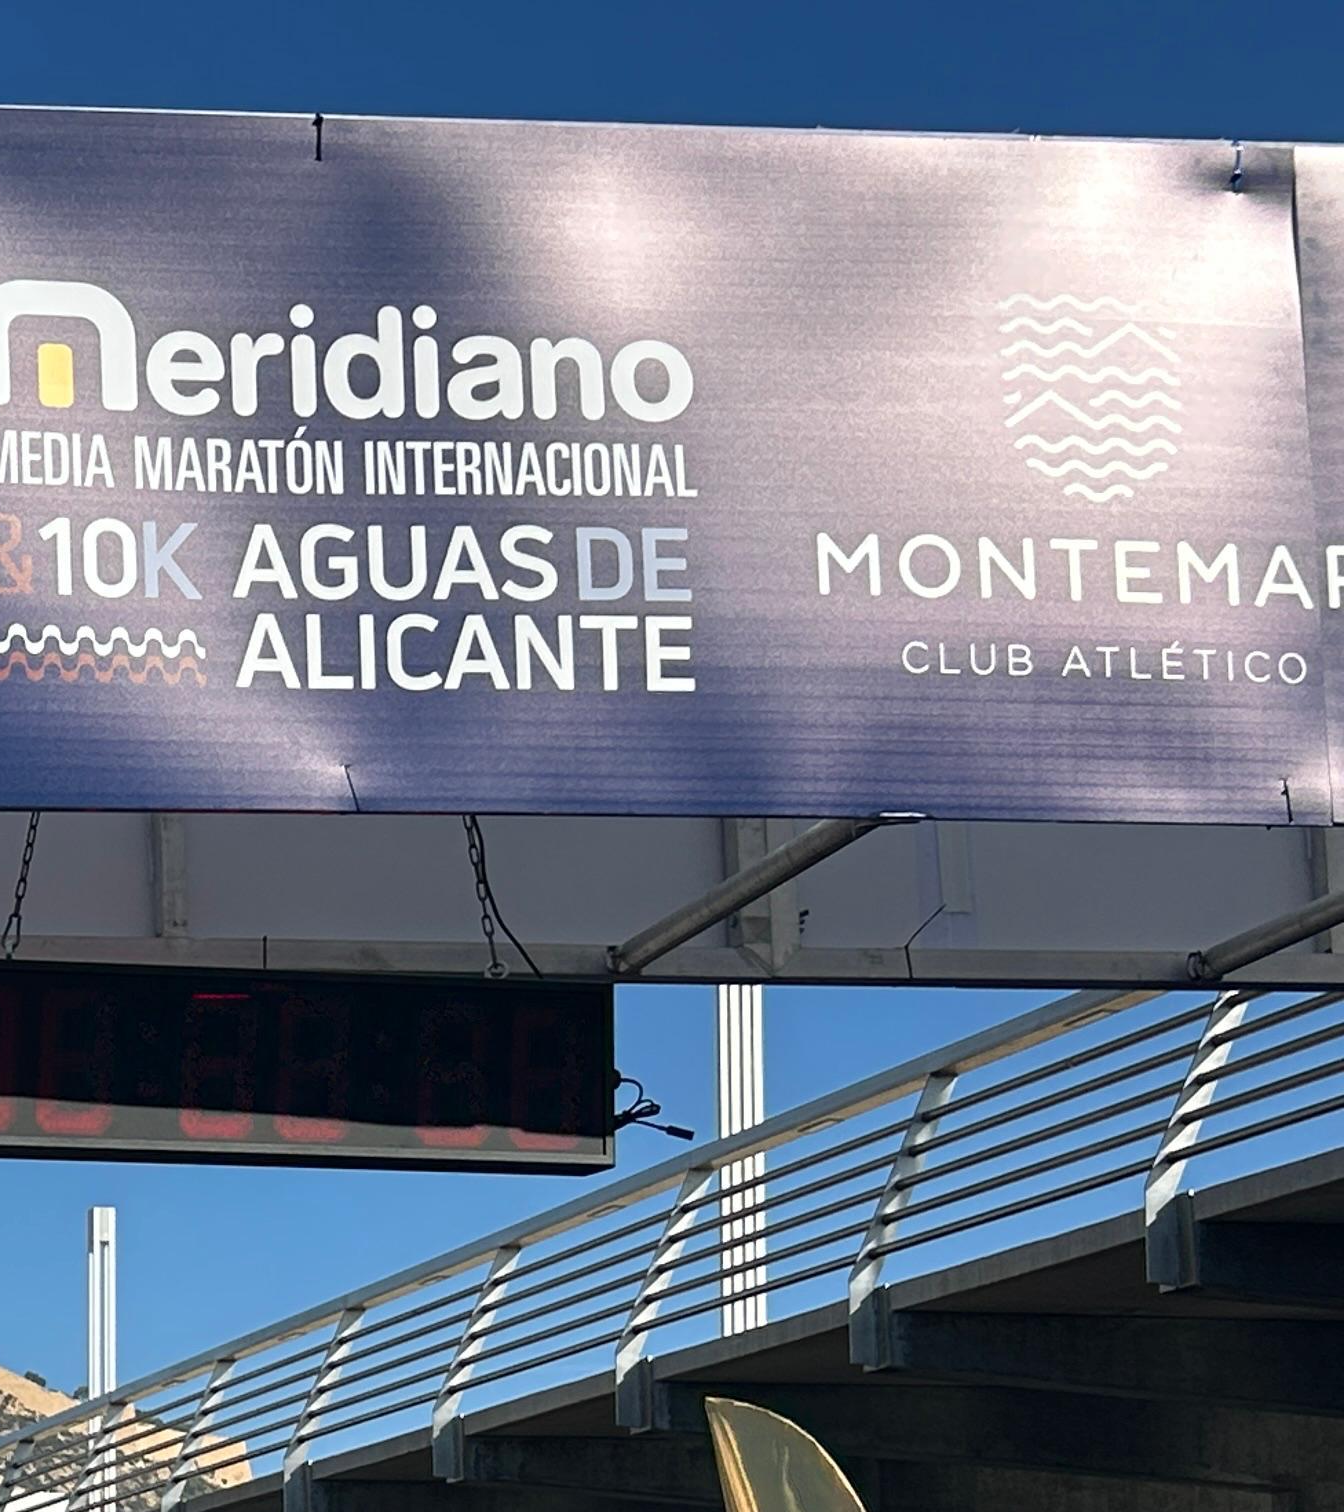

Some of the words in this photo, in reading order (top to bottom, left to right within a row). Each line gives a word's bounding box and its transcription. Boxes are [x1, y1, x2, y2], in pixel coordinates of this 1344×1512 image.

[133, 425, 345, 496] MARATÓN
[364, 440, 699, 498] INTERNACIONAL
[233, 524, 558, 603] AGUAS
[576, 527, 692, 601] DE
[235, 612, 698, 694] ALICANTE
[901, 640, 1035, 677] CLUB
[1061, 640, 1308, 685] ATLÉTICO
